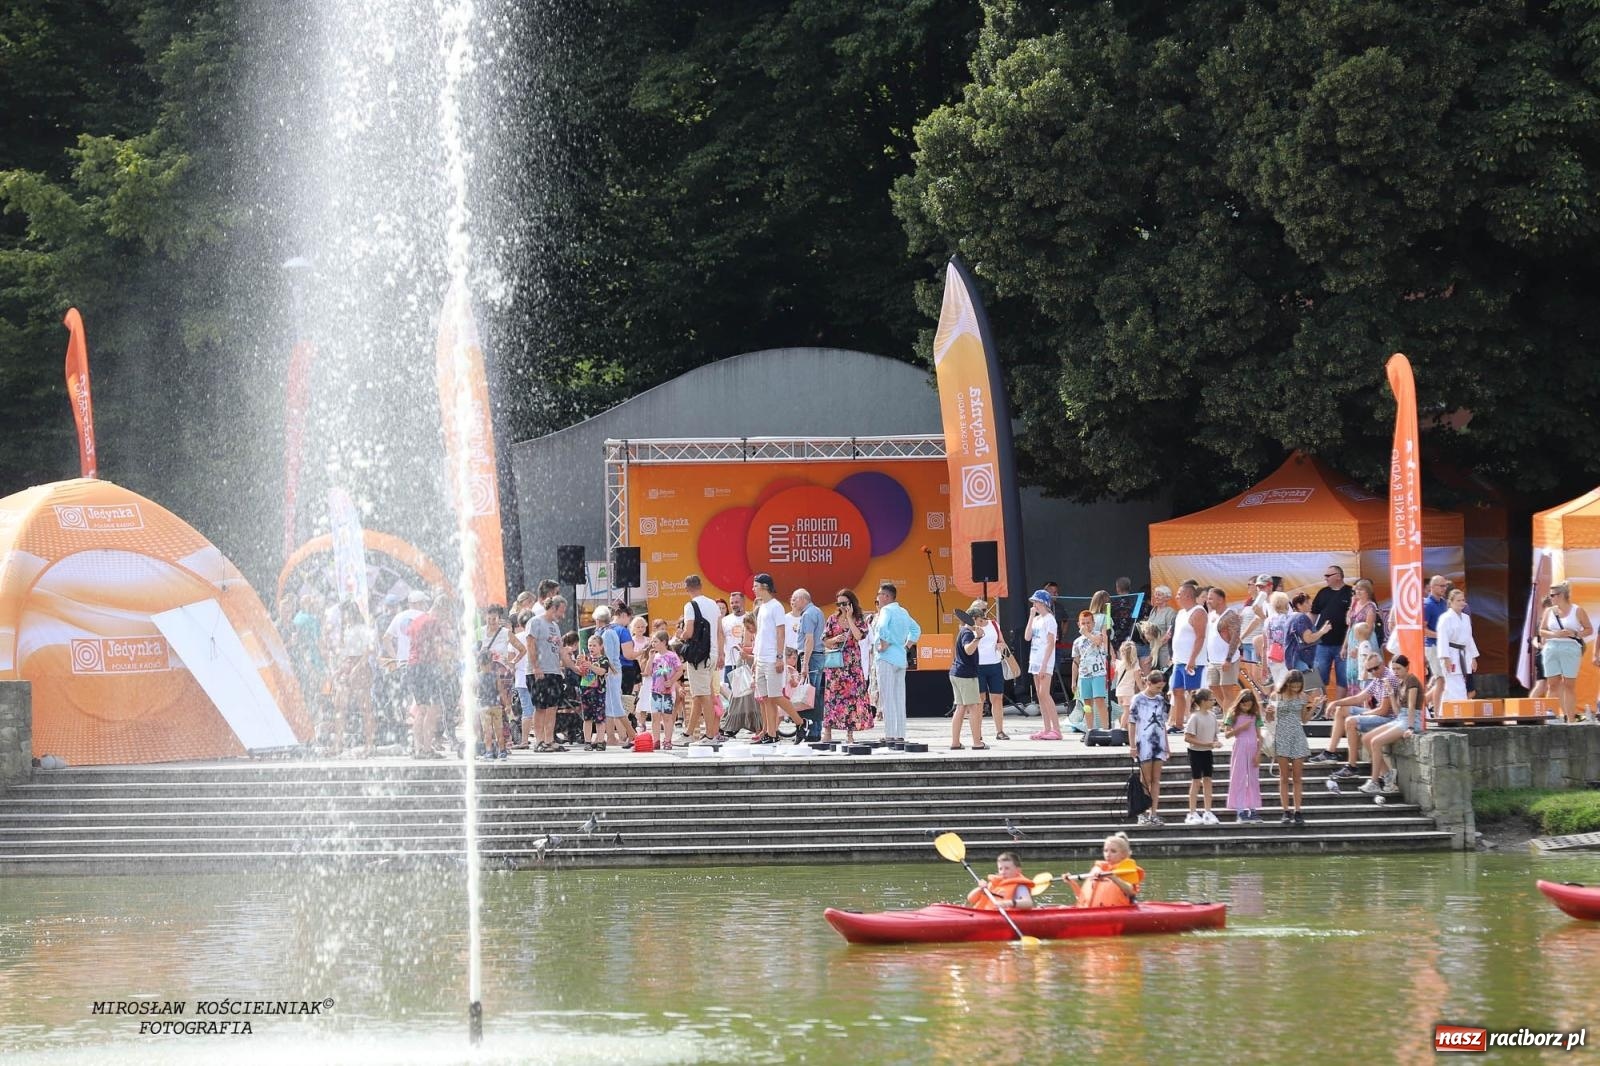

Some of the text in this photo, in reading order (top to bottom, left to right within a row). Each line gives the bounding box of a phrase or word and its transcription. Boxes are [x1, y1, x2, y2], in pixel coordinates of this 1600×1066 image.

[797, 518, 837, 531] RADIEM
[769, 525, 789, 562] LATO
[796, 533, 850, 549] TELEWIZJĄ
[792, 549, 832, 564] POLSKĄ
[107, 640, 162, 661] Jedynka
